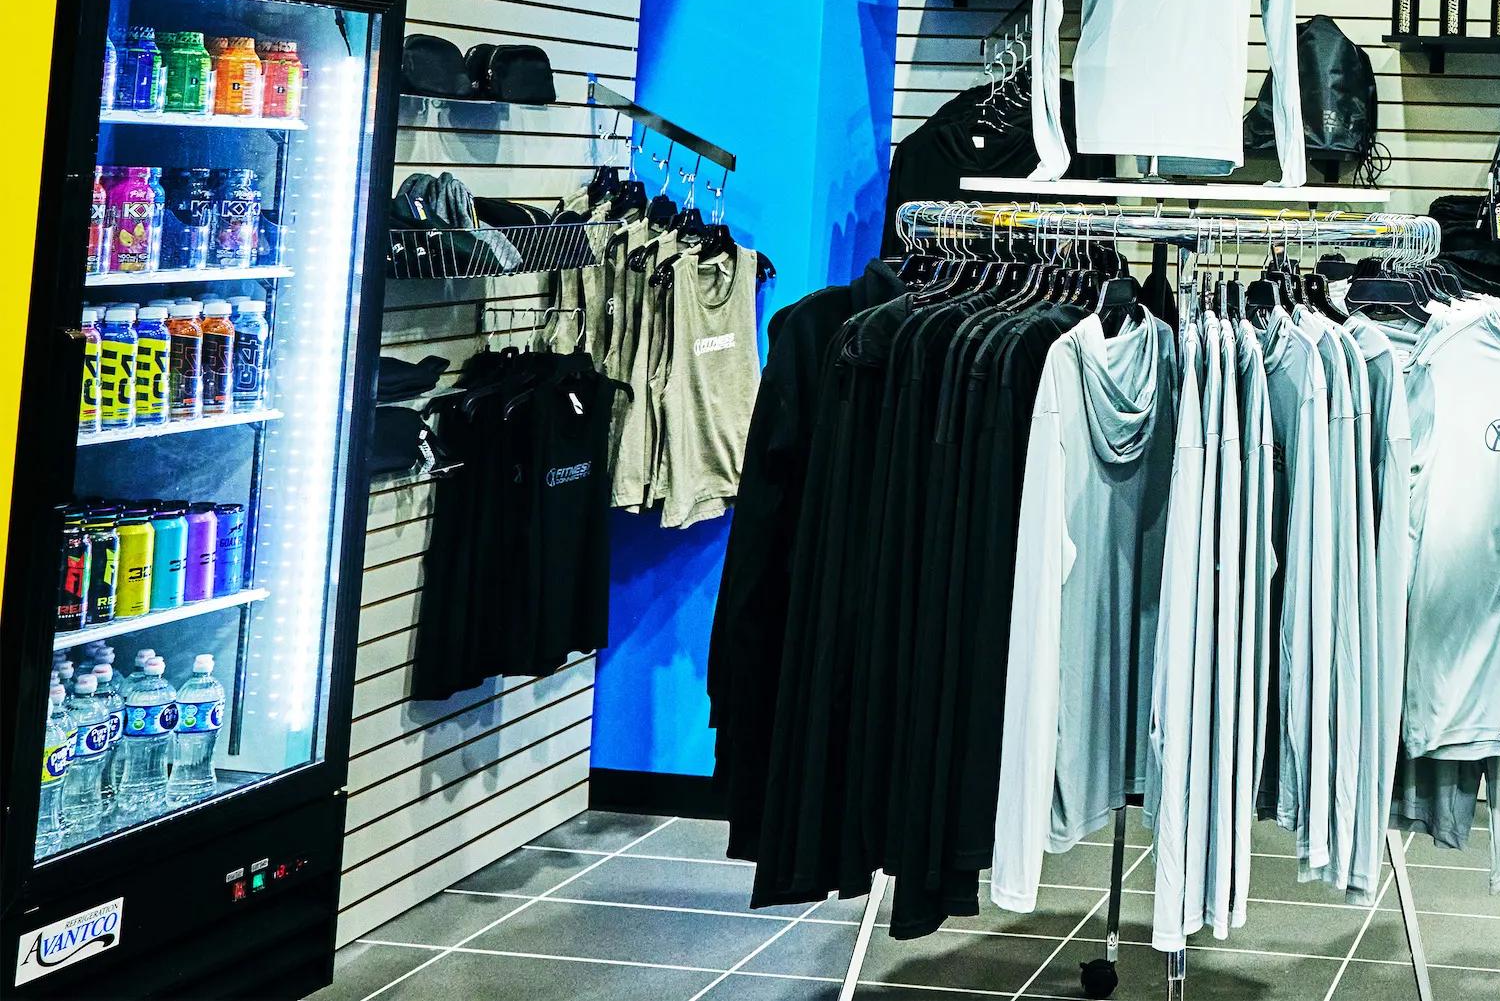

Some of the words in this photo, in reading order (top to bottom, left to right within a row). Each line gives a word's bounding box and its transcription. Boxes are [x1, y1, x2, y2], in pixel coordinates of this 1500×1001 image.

[242, 84, 254, 111] TOTAL
[236, 340, 260, 390] C4
[65, 903, 120, 930] REFRIGERATION
[20, 913, 118, 967] AVANTCO
